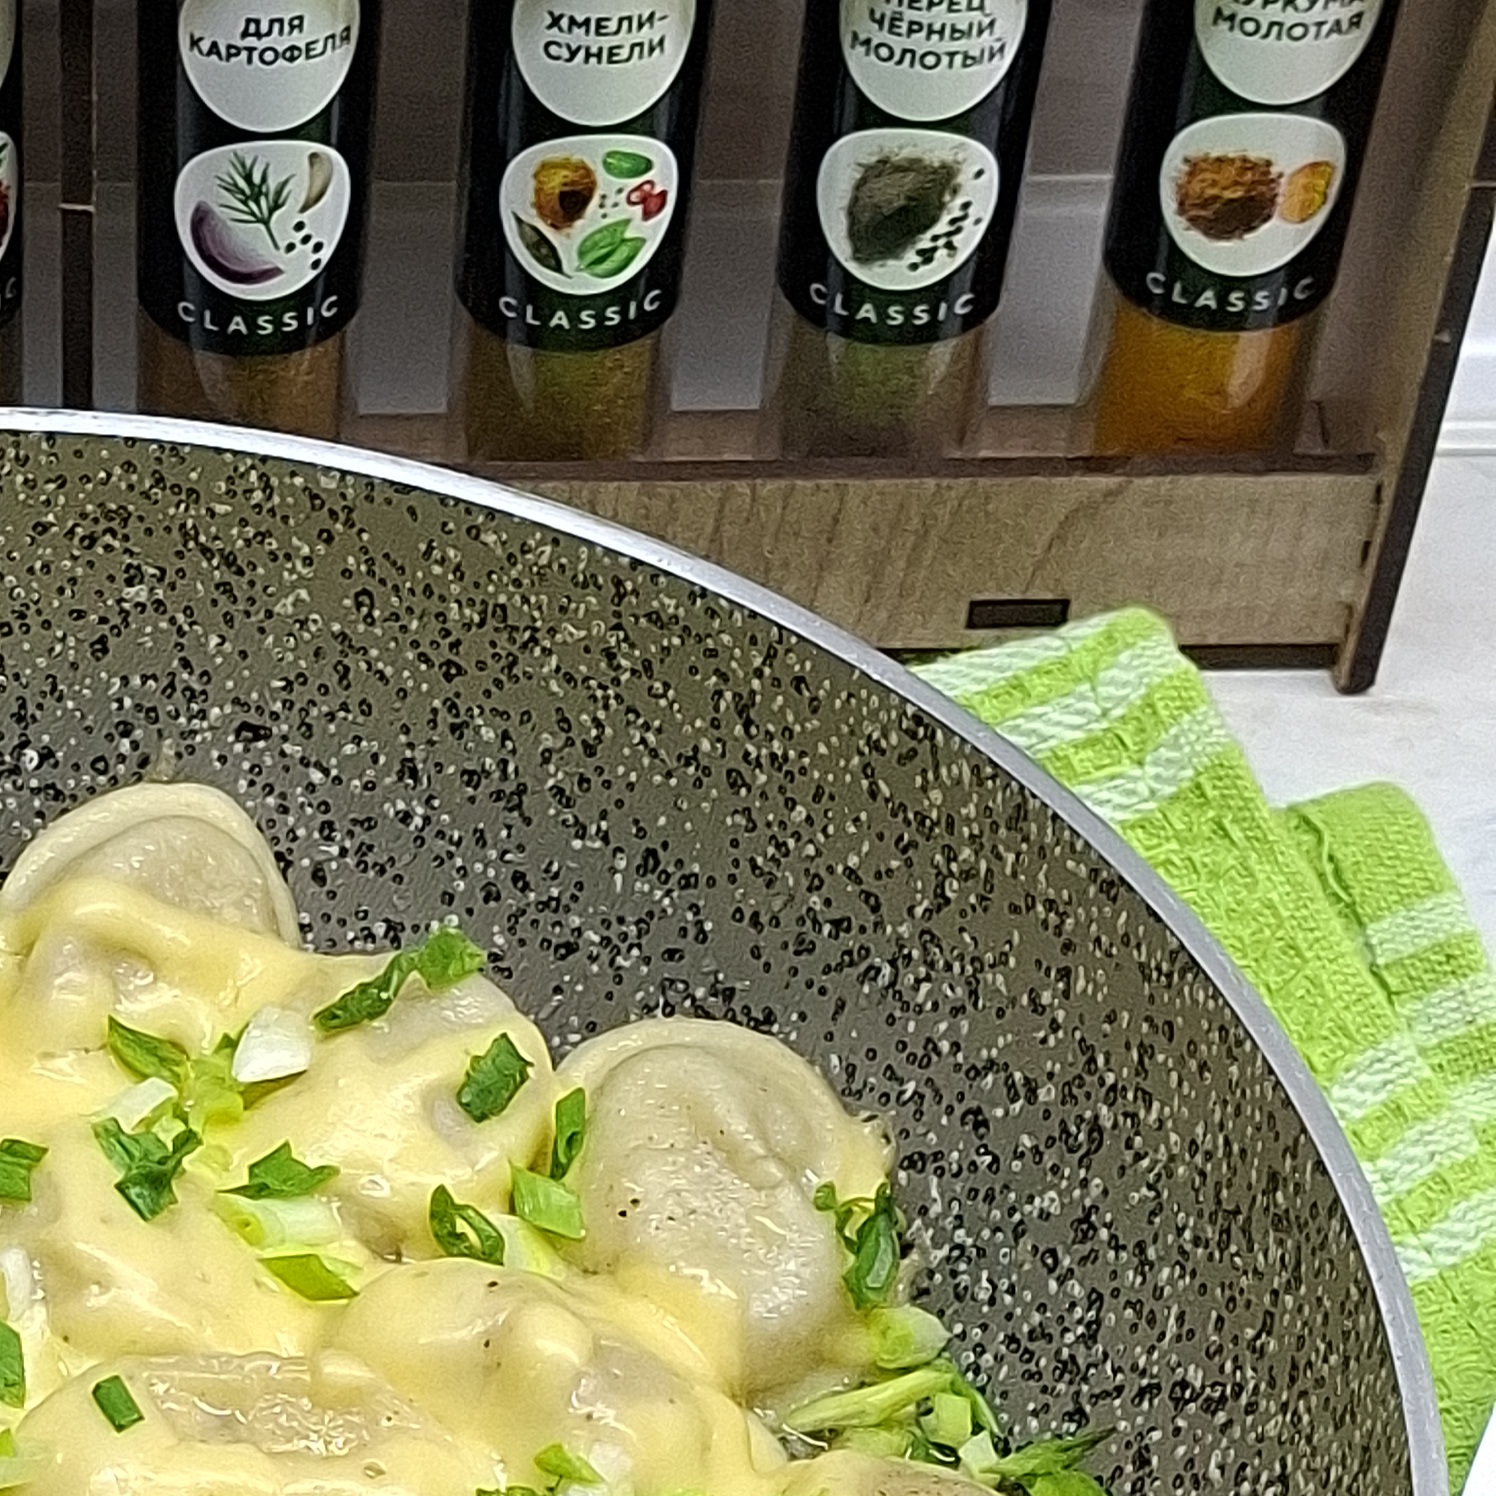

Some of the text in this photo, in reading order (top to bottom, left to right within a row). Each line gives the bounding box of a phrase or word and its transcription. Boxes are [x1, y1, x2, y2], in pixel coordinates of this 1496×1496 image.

[240, 14, 305, 41] ДЛЯ
[546, 10, 669, 39] ХМЕЛИ-
[869, 8, 997, 42] ЧЁРНЫЙ
[1212, 6, 1365, 42] МОЛОТАЯ
[188, 26, 352, 66] КАРТОФЕЛЯ
[542, 37, 667, 66] СУНЕЛИ
[850, 30, 1007, 70] МОЛОТЫЙ
[498, 289, 663, 330] CLASSIC
[809, 282, 977, 326] CLASSIC
[1145, 272, 1316, 313] CLASSIC
[177, 294, 340, 336] CLASSIC
